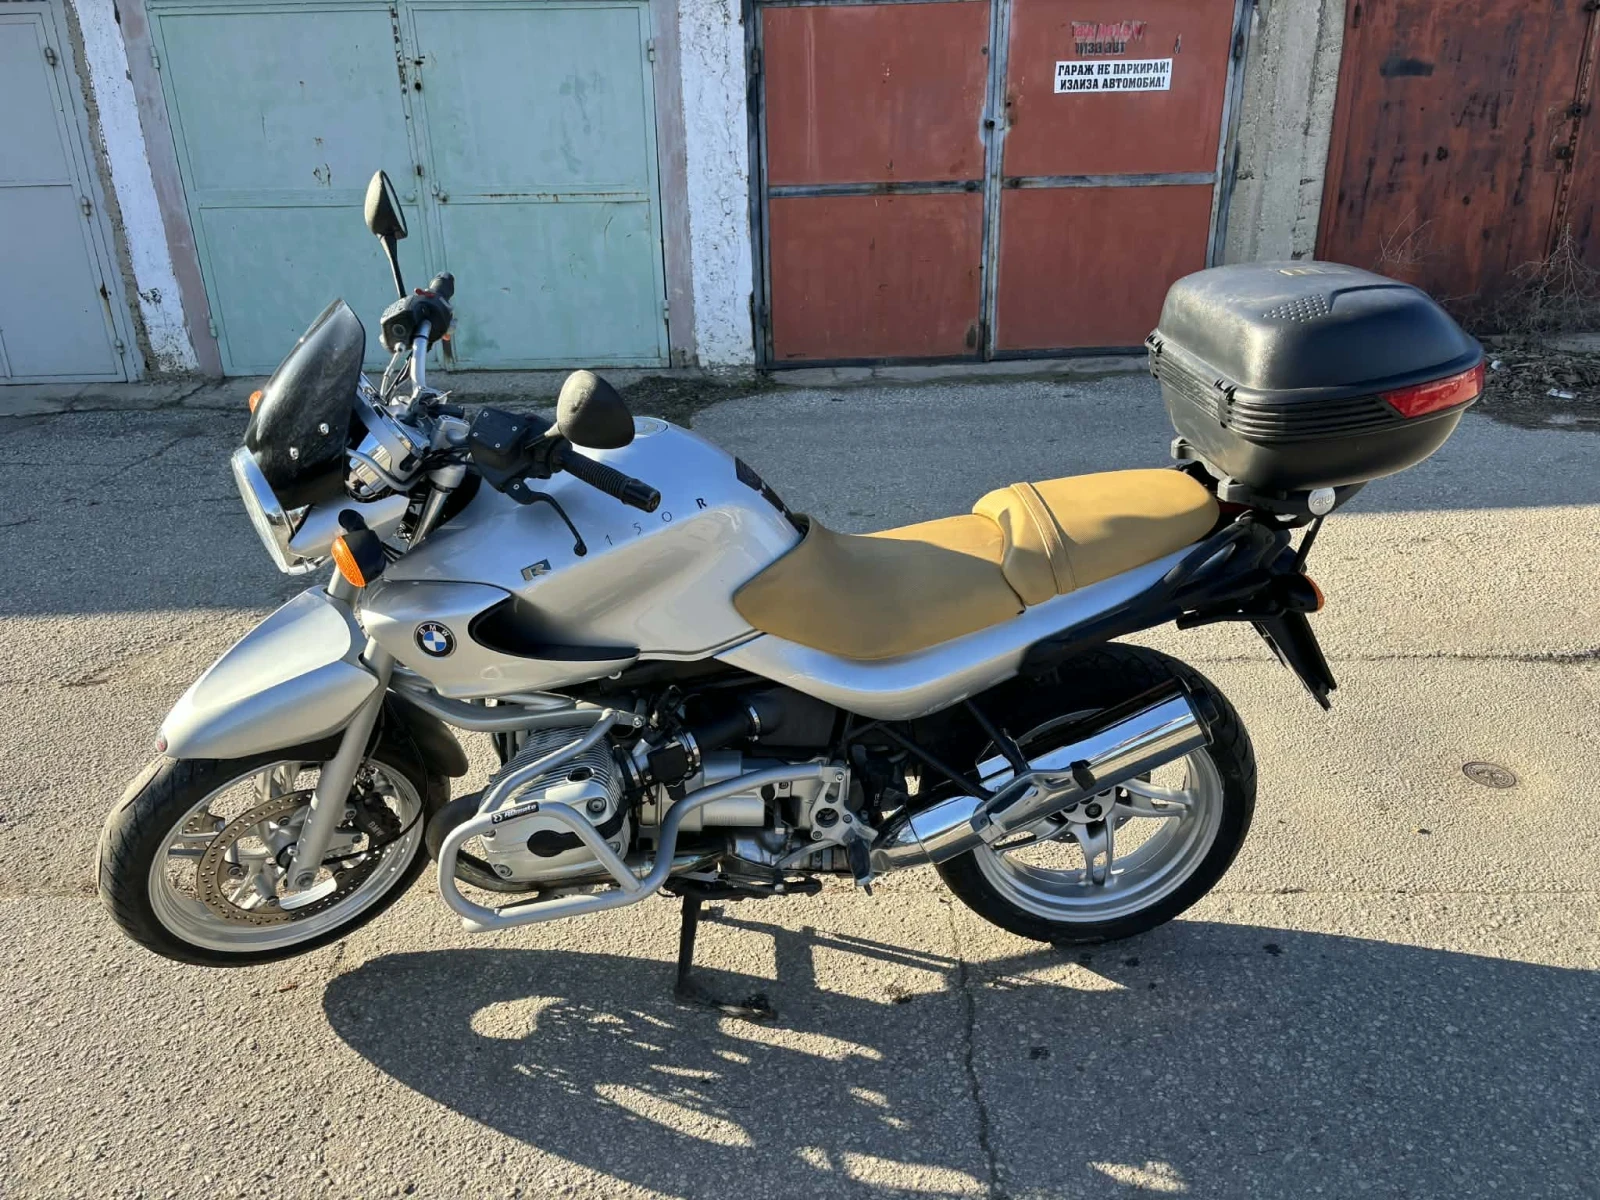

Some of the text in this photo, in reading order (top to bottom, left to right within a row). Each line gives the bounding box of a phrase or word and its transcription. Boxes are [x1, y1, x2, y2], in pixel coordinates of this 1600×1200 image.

[1058, 61, 1169, 76] ГАРАЖ НЕ ПАРКИРАЙ!
[1060, 76, 1166, 90] ИЗЛИЗА АВТОМОБИЛ!
[418, 624, 450, 637] BMW
